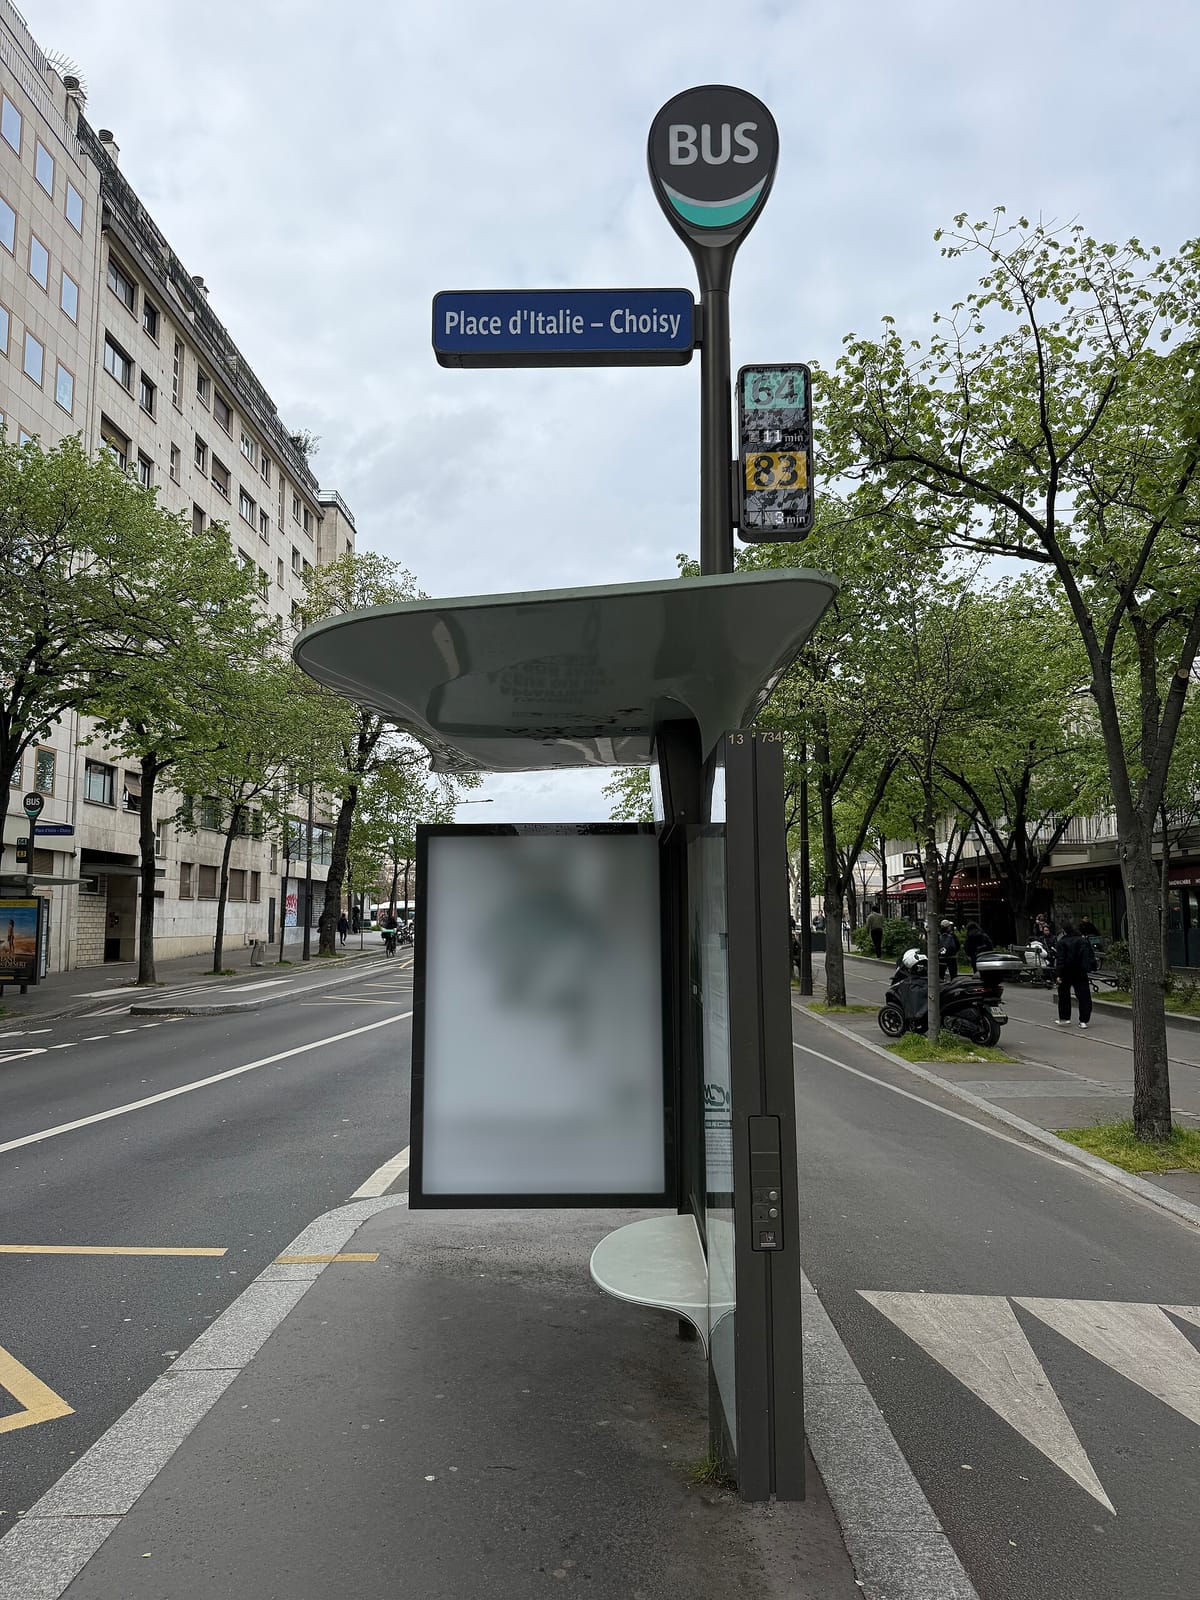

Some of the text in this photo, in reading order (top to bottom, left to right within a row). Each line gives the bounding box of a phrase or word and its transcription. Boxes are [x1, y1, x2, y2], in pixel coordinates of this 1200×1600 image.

[668, 121, 759, 166] BUS
[445, 311, 502, 336] Place
[509, 310, 584, 335] d'Italie
[609, 308, 681, 339] Choisy
[751, 374, 798, 406] 64
[763, 430, 804, 443] 11 min
[753, 455, 798, 487] 83
[786, 514, 806, 524] min
[728, 734, 744, 745] 13
[26, 797, 40, 806] BUS
